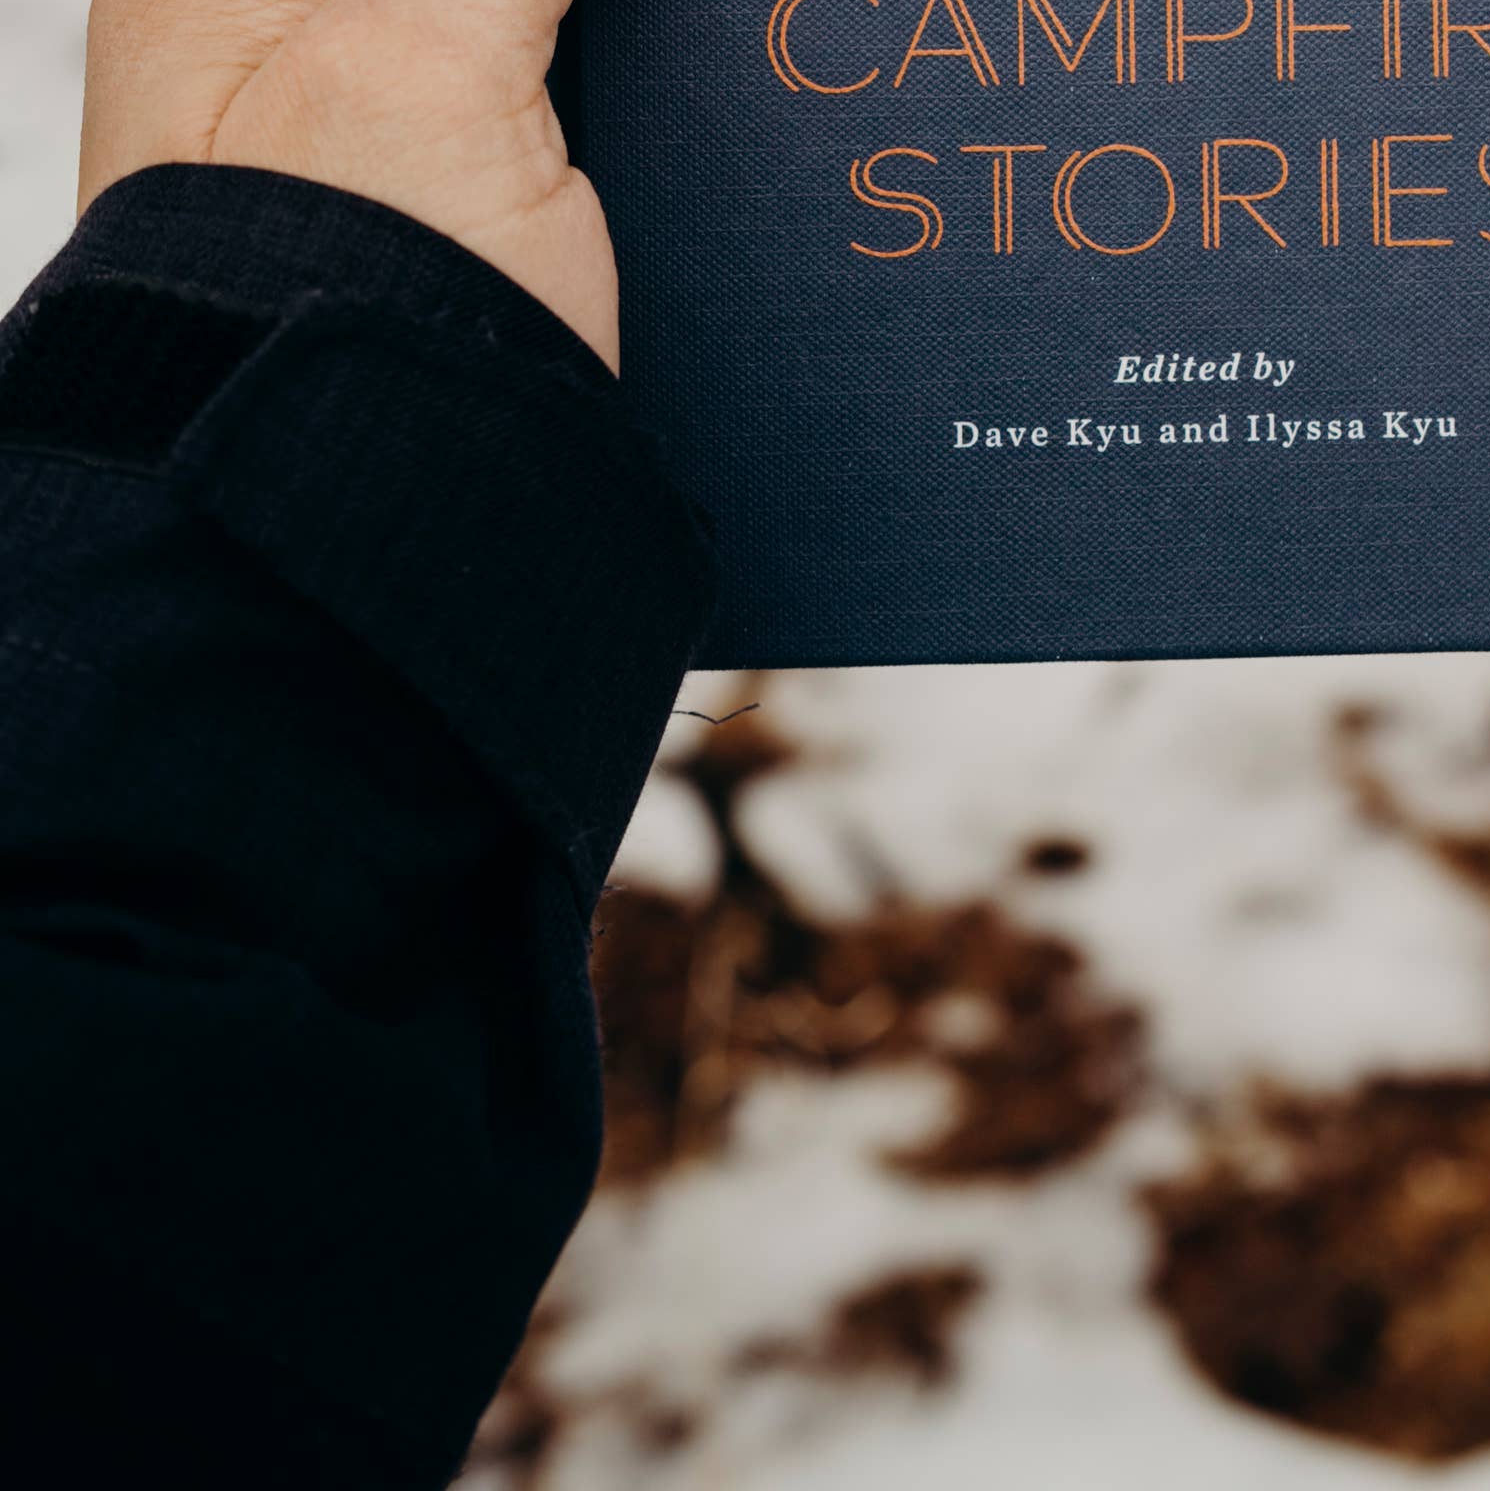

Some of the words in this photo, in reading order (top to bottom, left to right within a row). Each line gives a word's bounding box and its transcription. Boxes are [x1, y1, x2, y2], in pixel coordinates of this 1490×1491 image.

[1114, 352, 1241, 383] Edited
[1253, 352, 1295, 387] by
[953, 421, 1048, 448] Dave
[1067, 418, 1141, 452] Kyu
[1159, 414, 1229, 444] and
[1247, 413, 1365, 448] Ilyssa
[1383, 411, 1457, 445] Kyu
